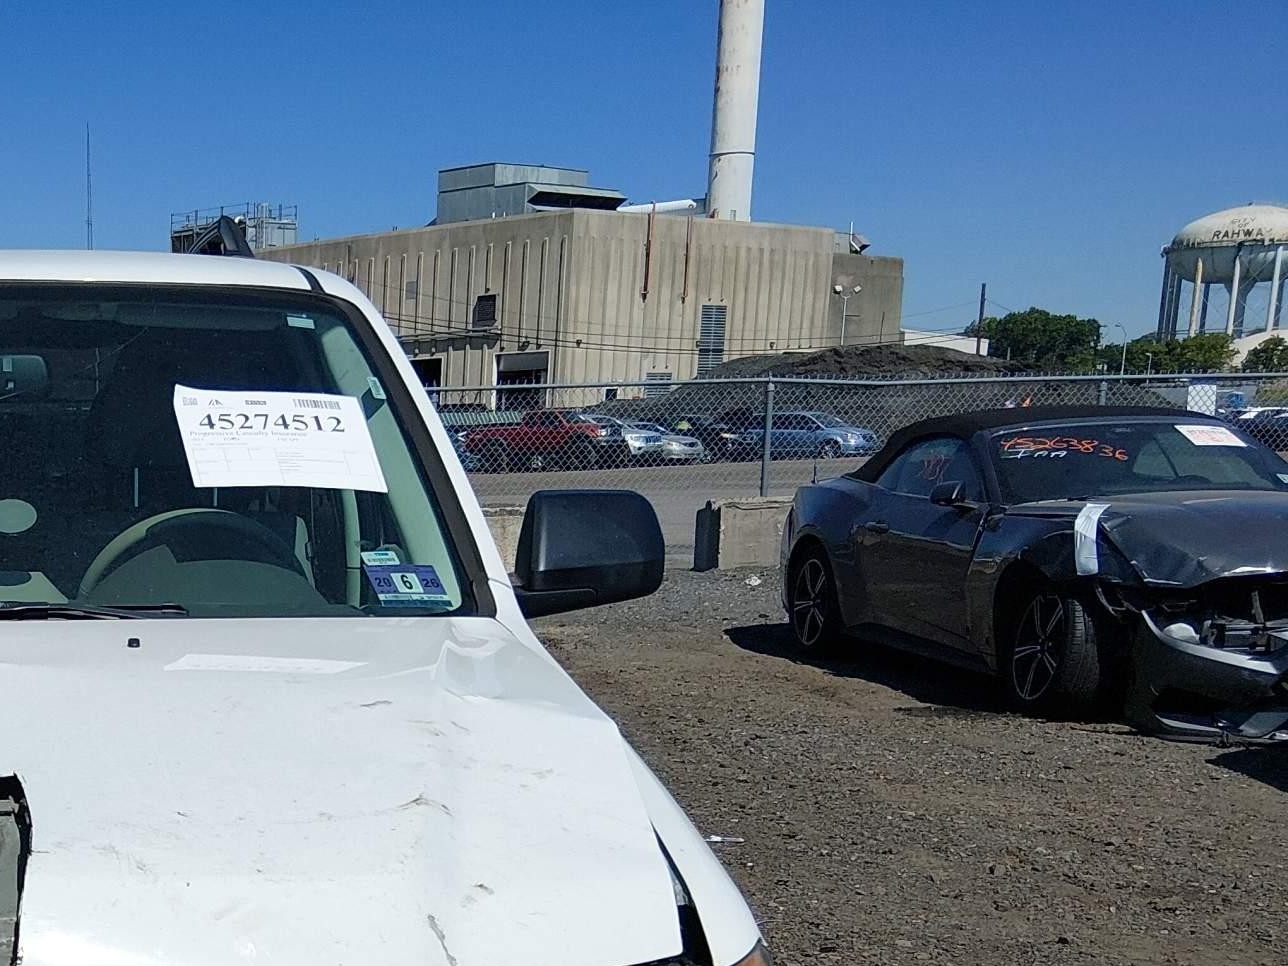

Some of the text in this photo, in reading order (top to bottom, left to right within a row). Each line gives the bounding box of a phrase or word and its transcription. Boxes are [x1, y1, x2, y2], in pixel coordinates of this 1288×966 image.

[199, 413, 345, 433] 45274512
[374, 574, 440, 590] 20 6 26
